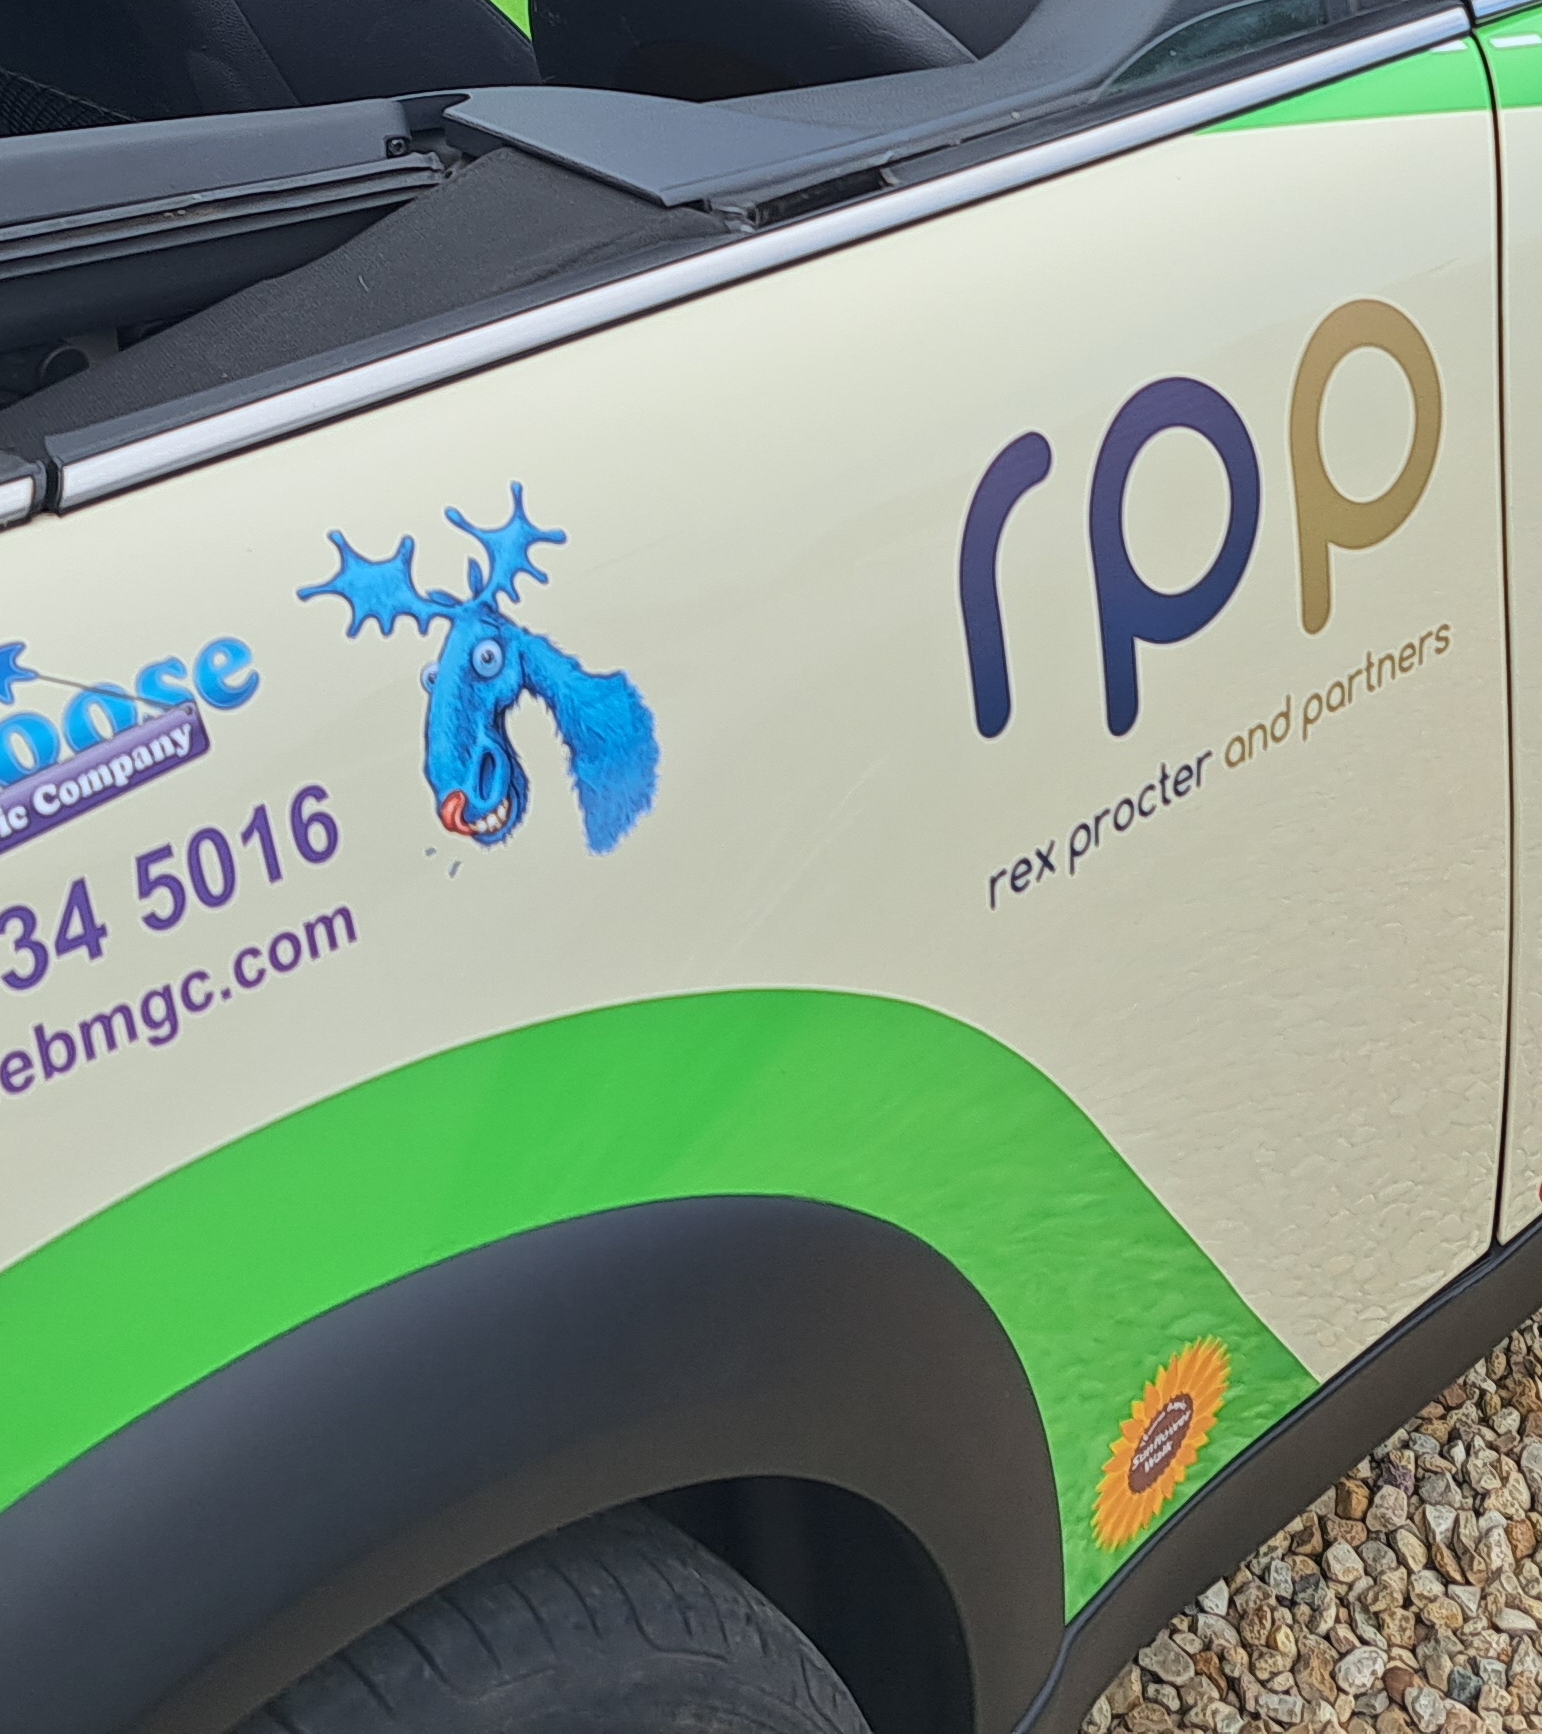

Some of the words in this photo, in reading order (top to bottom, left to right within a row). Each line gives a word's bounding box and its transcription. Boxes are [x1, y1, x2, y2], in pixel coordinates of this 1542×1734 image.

[959, 298, 1443, 738] rpp
[31, 719, 197, 824] Company
[135, 784, 340, 930] 5016
[988, 841, 1056, 910] rex
[1069, 749, 1213, 875] procter
[1223, 694, 1292, 768] and
[1302, 622, 1453, 741] partners
